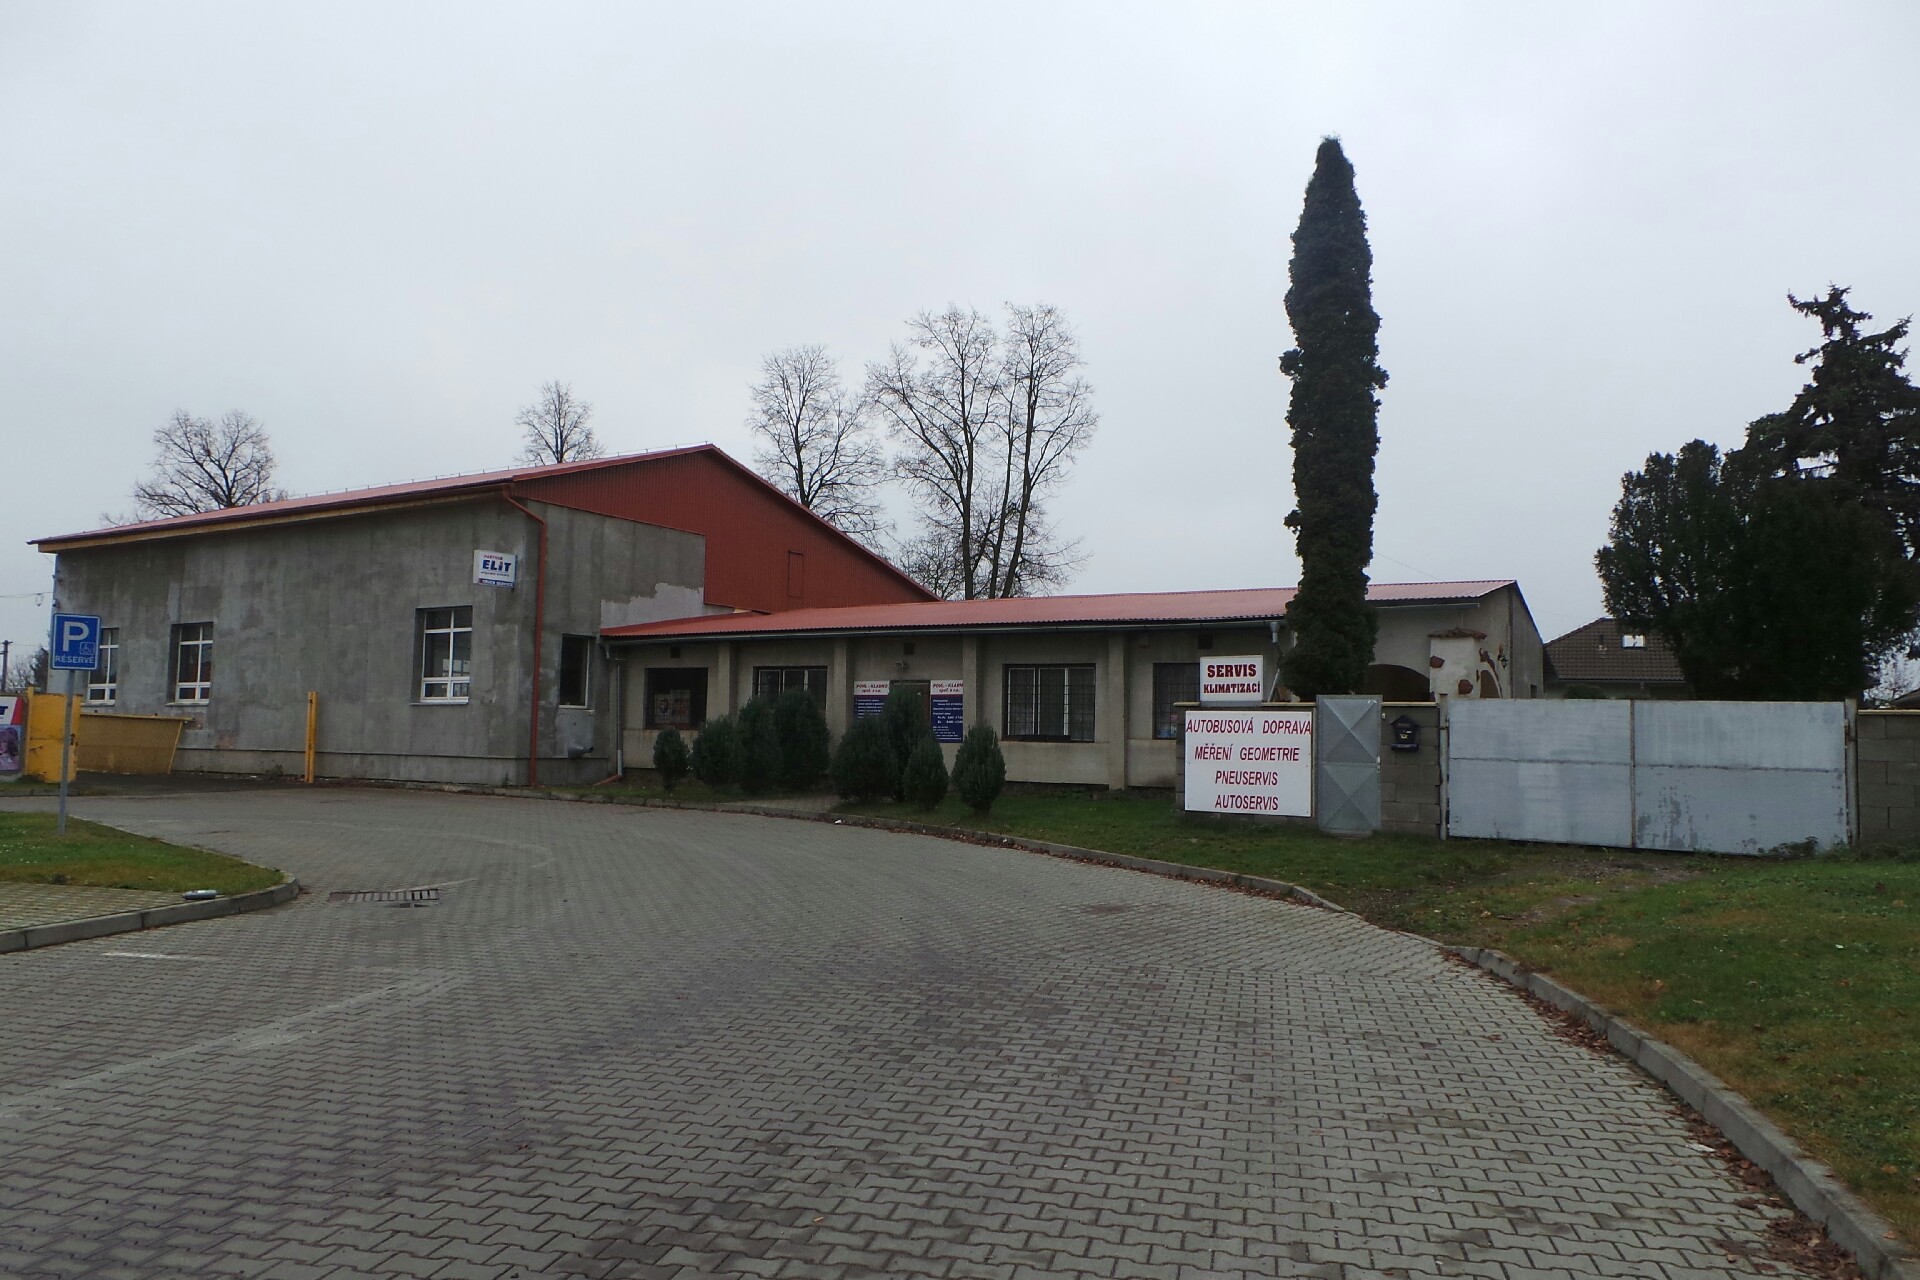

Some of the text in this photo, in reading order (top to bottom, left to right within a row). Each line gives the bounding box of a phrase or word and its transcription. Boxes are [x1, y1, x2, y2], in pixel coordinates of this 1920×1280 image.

[63, 621, 89, 652] P
[1207, 664, 1257, 678] SERVIS
[1203, 681, 1261, 694] KLIMATIZACÍ
[1185, 717, 1312, 735] AUTOBUSOVÁ DOPRAVA
[1194, 743, 1300, 761] MĚŘENÍ GEOMETRIE
[1215, 770, 1278, 786] PNEUSERVIS
[1215, 795, 1279, 810] AUTOSERVIS
